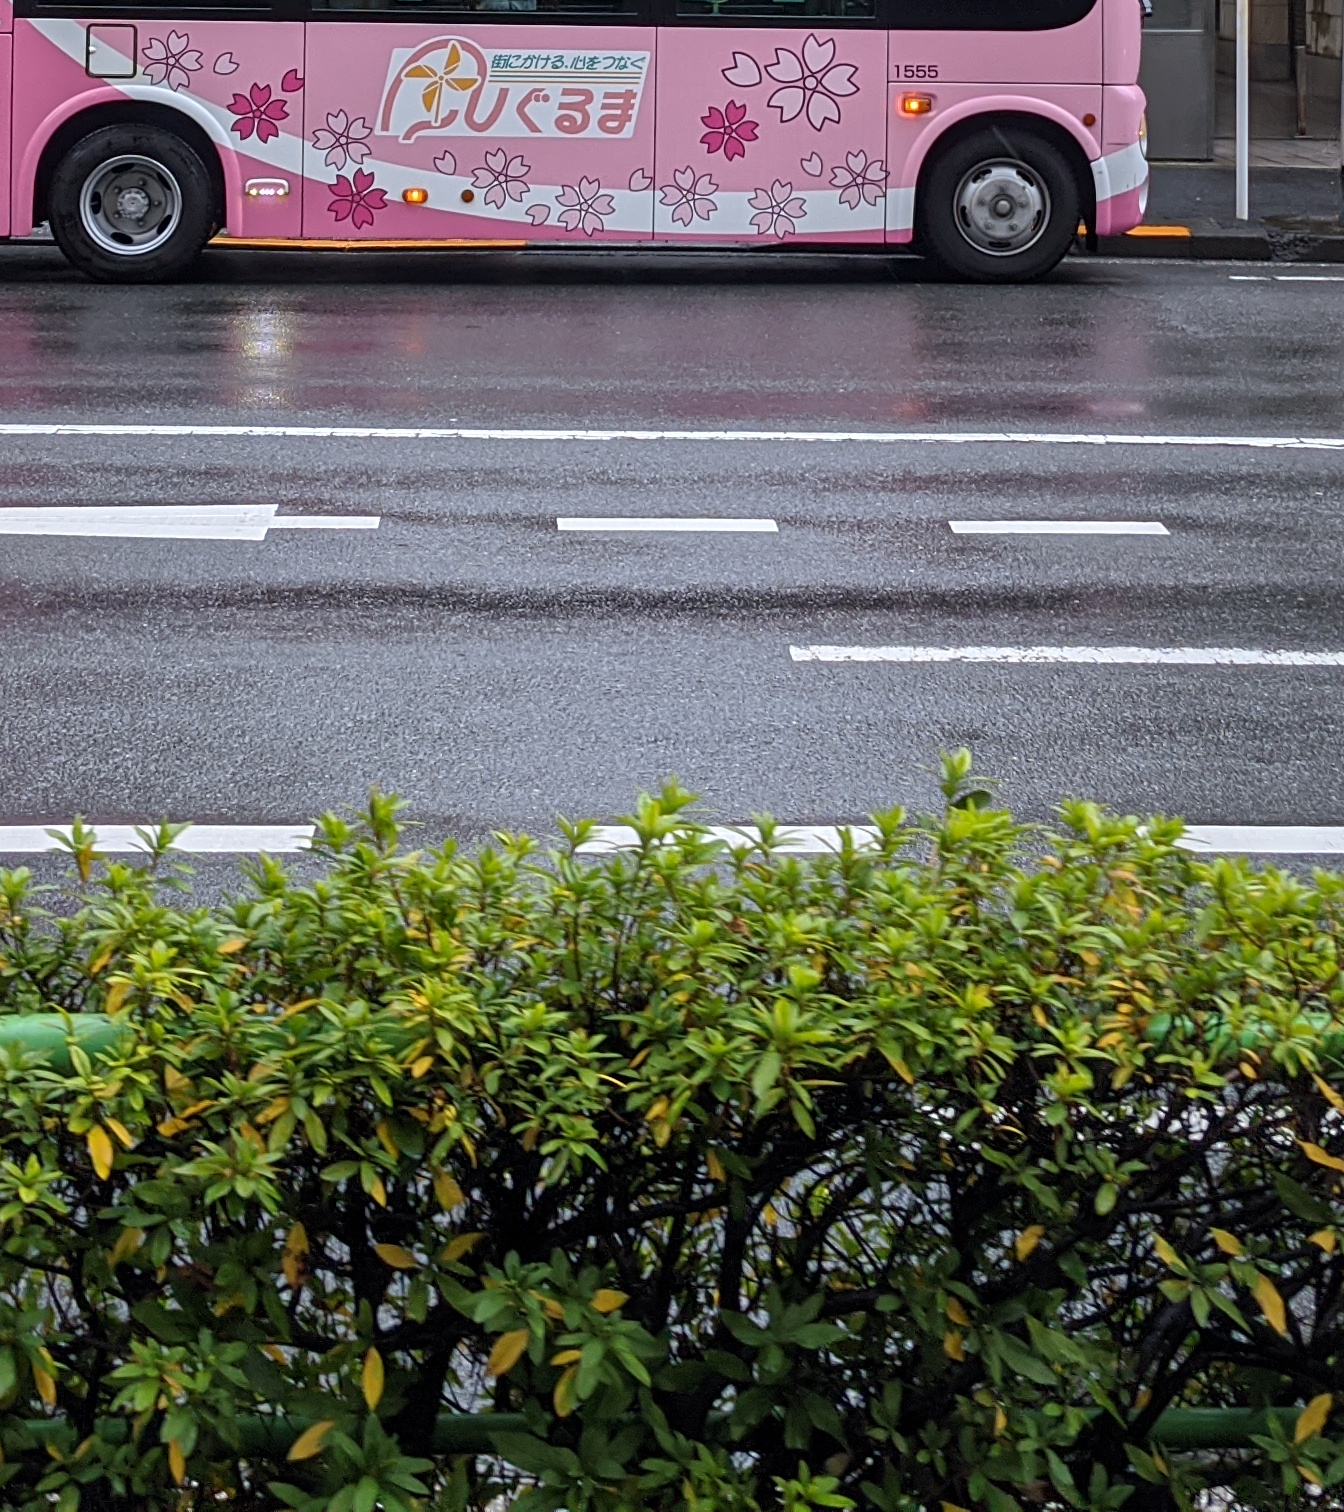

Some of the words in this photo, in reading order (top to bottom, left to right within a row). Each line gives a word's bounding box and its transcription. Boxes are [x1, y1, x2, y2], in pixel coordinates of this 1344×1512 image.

[490, 53, 647, 71] 街にかける、心をつなぐ
[894, 64, 939, 79] 1555
